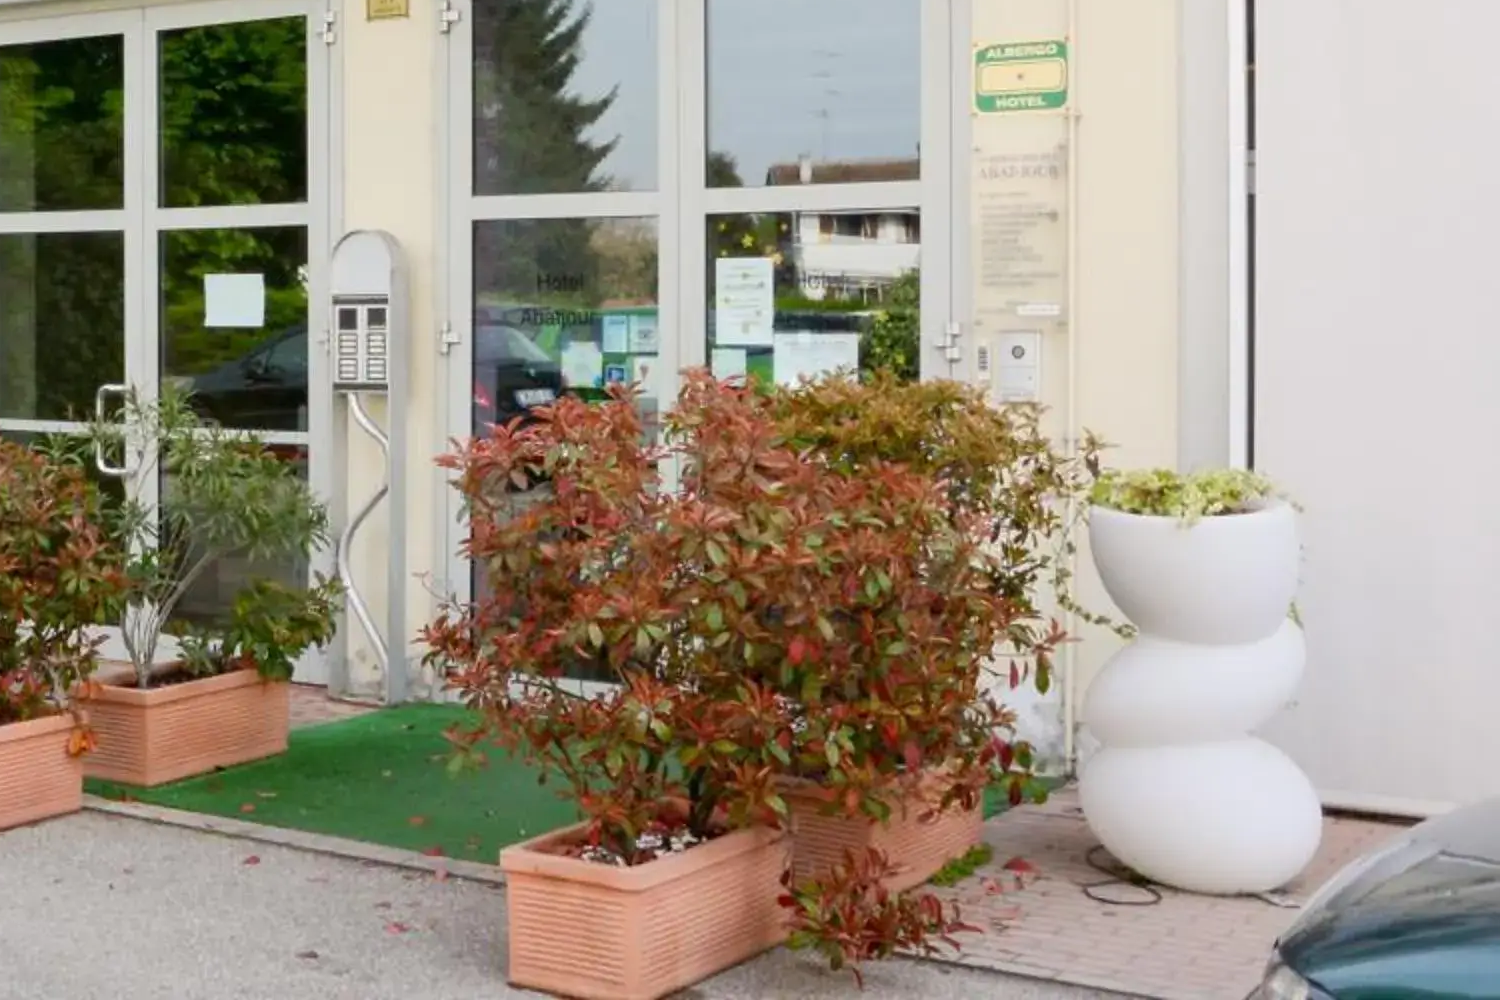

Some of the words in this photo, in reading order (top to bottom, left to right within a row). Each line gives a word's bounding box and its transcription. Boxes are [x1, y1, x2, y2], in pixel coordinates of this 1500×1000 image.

[985, 43, 1057, 59] ALBERGO
[995, 96, 1047, 109] HOTEL
[537, 272, 584, 292] Hotel
